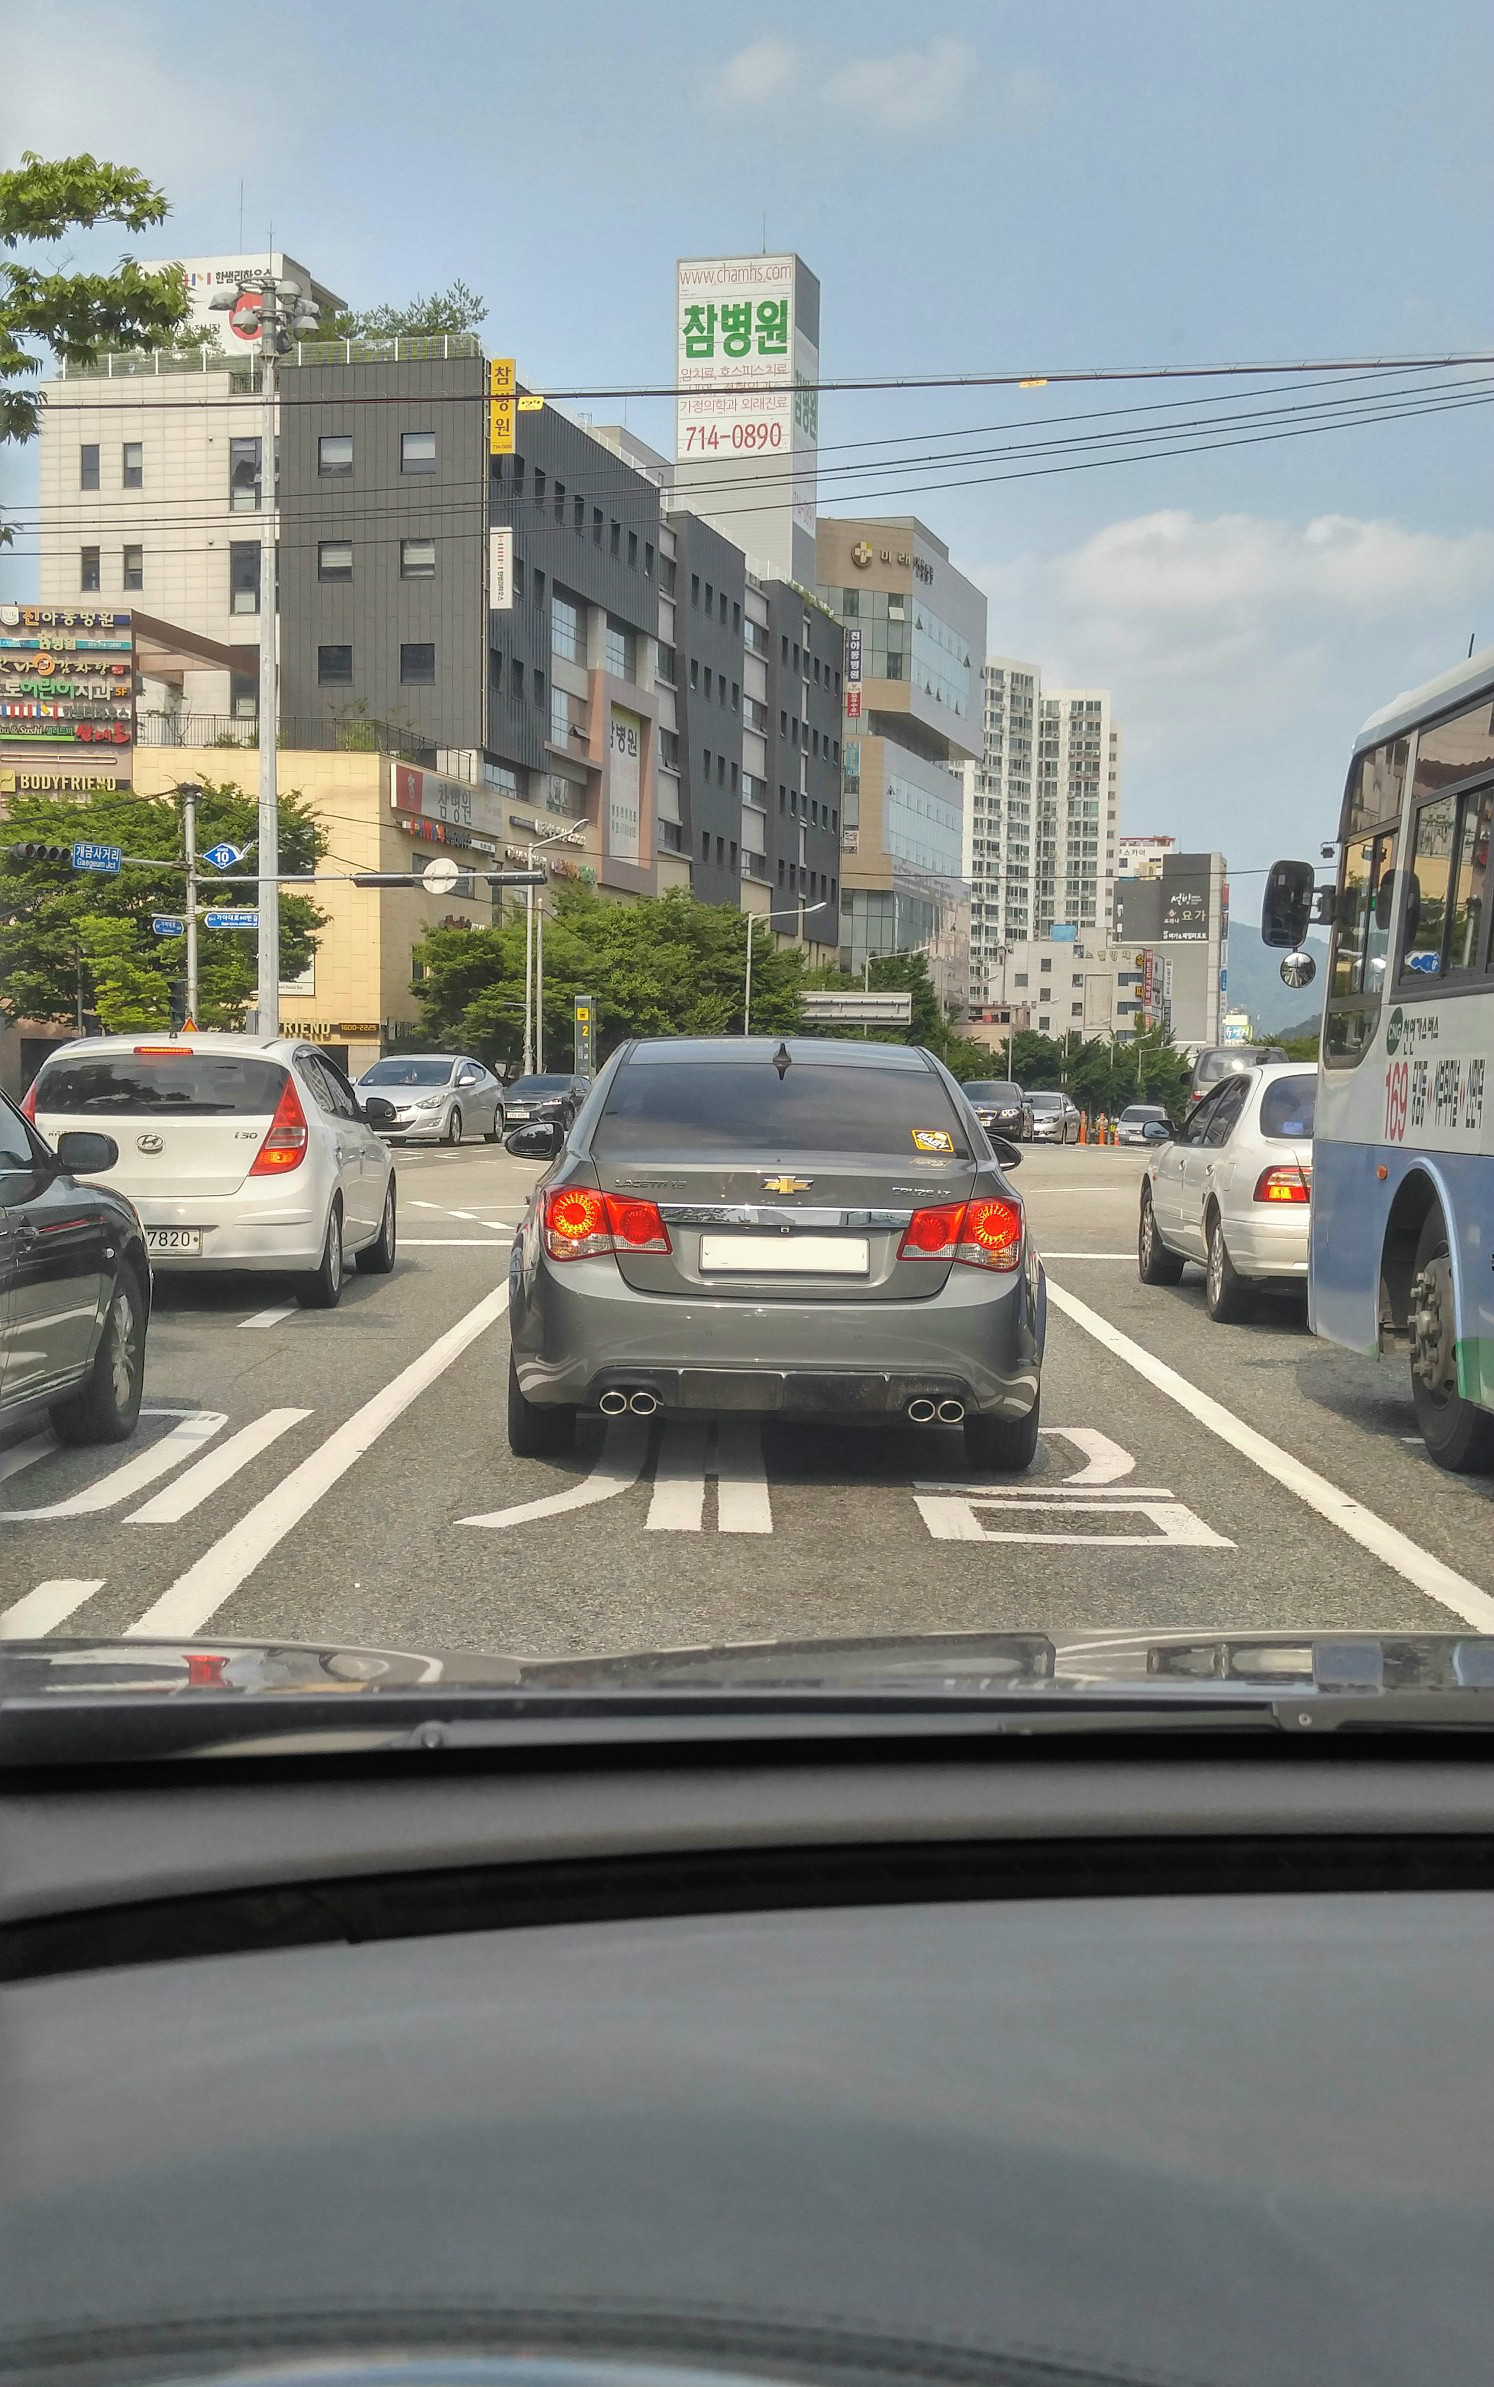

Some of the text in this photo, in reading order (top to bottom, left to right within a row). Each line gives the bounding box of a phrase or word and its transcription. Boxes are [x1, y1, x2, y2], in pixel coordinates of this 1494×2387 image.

[680, 263, 792, 286] www.chamhs.com
[683, 300, 788, 359] 참병원
[493, 366, 512, 437] 참병원
[680, 397, 788, 415] 가정의학과 외래진료
[685, 422, 782, 452] 714-0890
[115, 687, 128, 697] 5F
[19, 725, 43, 735] Sushi
[20, 774, 116, 791] BODYFRIEND
[438, 784, 472, 826] 참병원
[76, 846, 119, 861] 개금사거리
[214, 851, 230, 863] 10
[77, 858, 116, 869] Gaegeum Jct
[1170, 892, 1192, 906] 설빙
[1181, 910, 1207, 922] 요가
[278, 1018, 331, 1035] RIEND
[582, 1025, 589, 1036] 2
[1388, 1022, 1403, 1041] CNG
[1403, 1016, 1439, 1055] 천연가스버스
[1384, 1060, 1409, 1142] 169
[234, 1131, 259, 1140] i30
[615, 1179, 668, 1189] LACETTI
[891, 1186, 934, 1198] CRUZE
[147, 1231, 190, 1247] 7820
